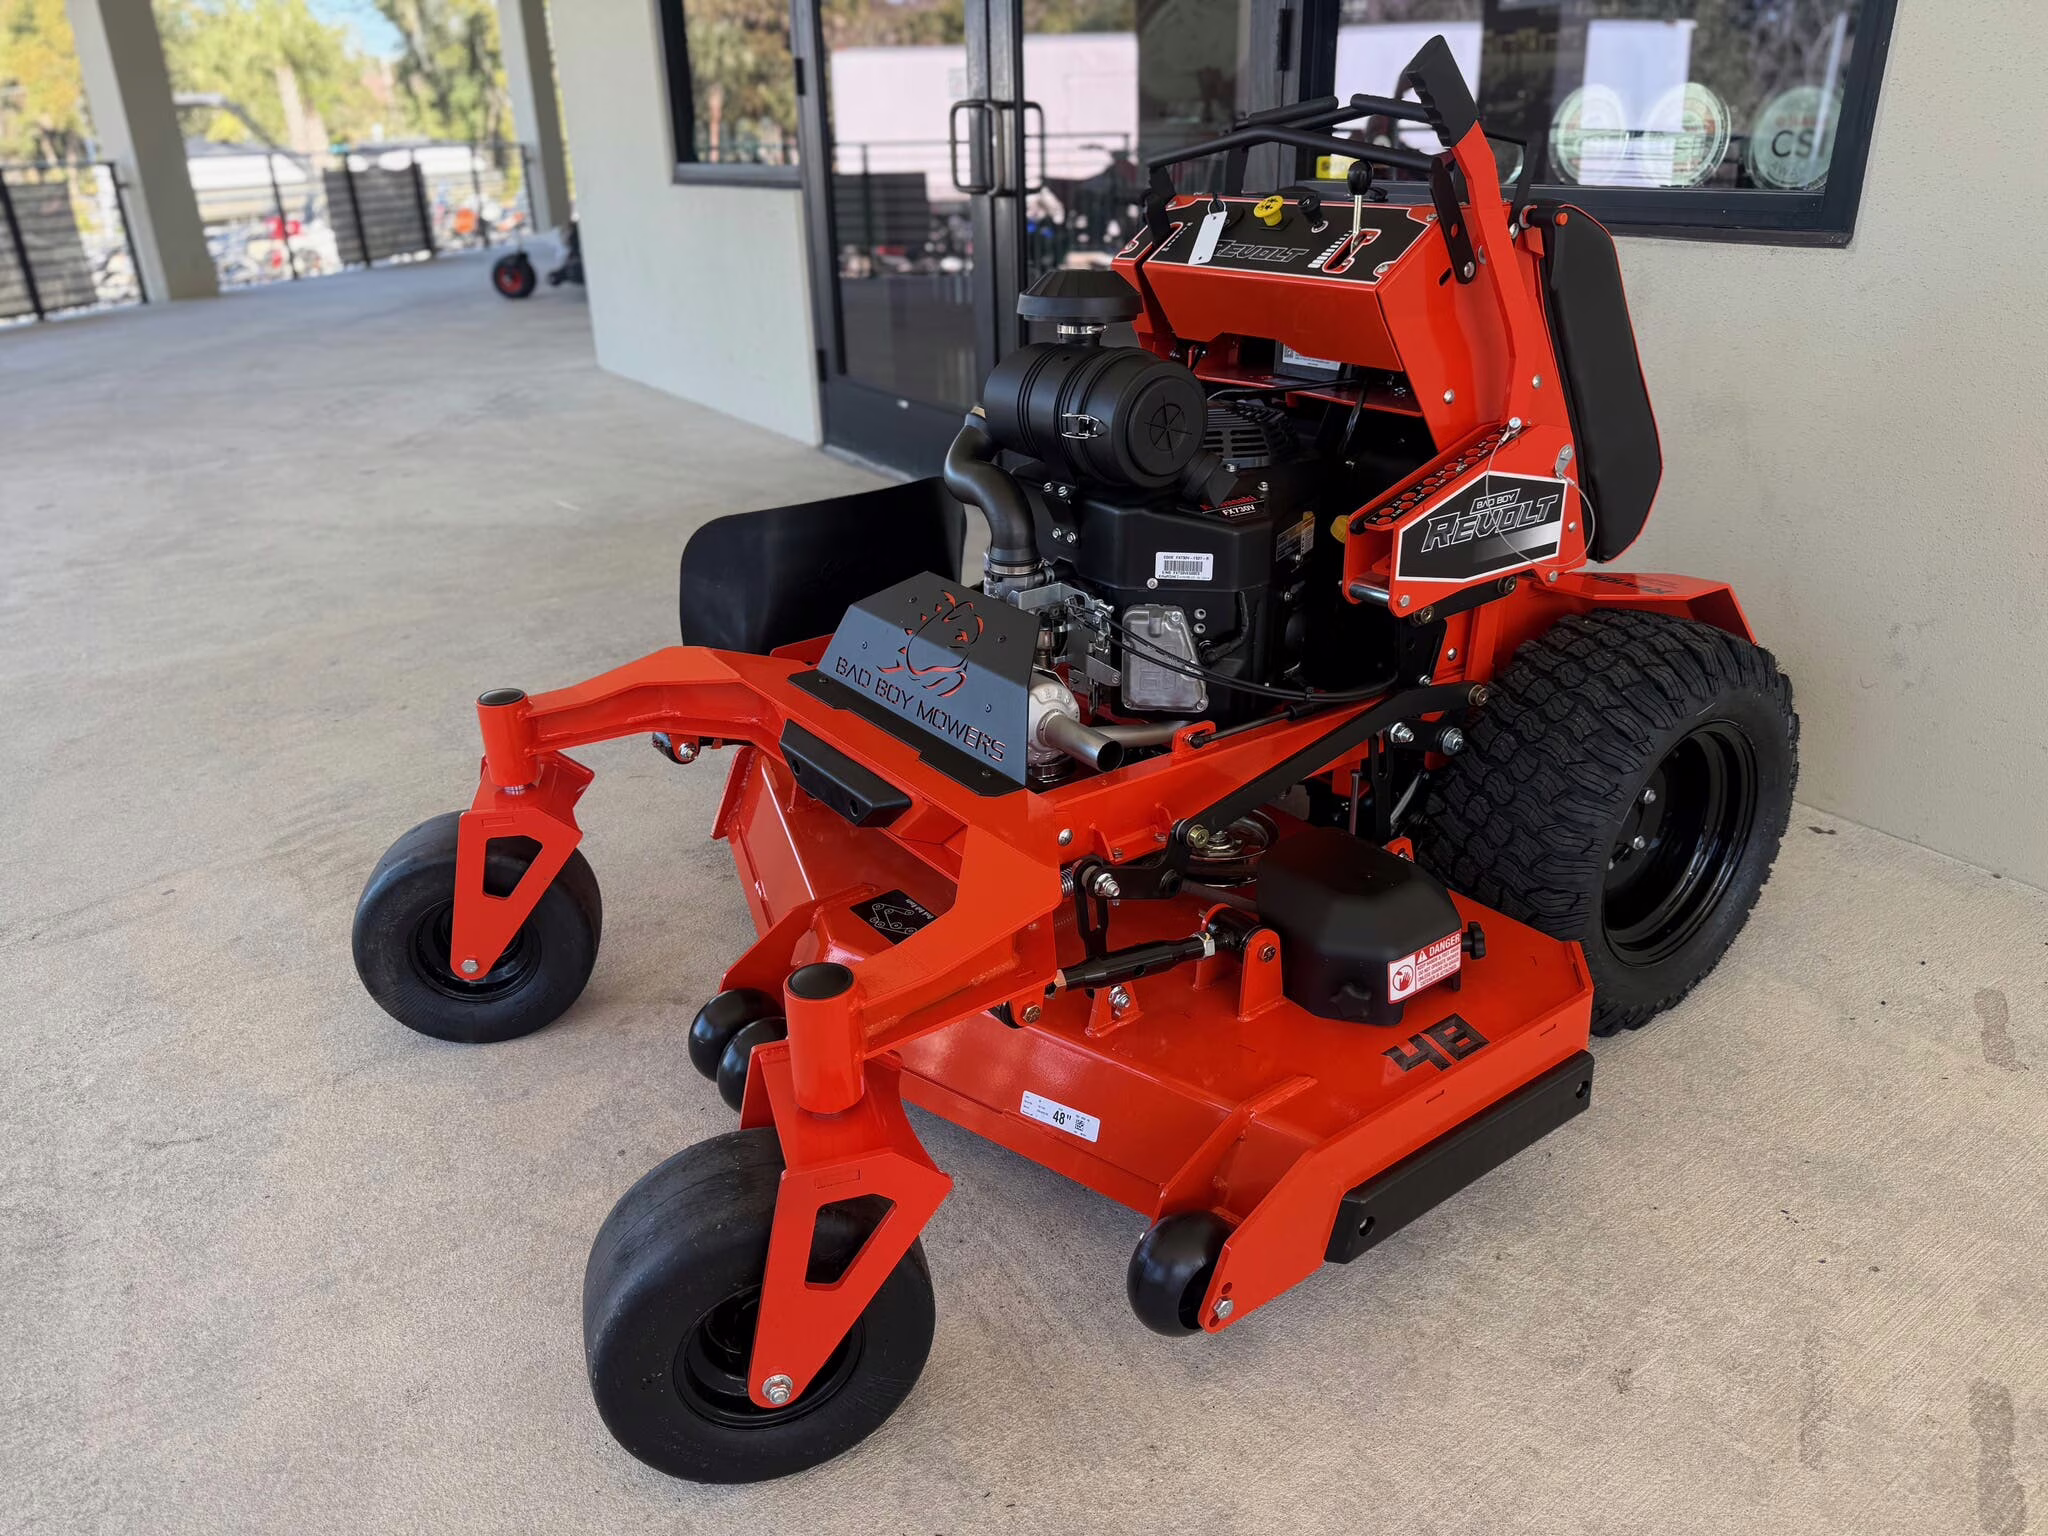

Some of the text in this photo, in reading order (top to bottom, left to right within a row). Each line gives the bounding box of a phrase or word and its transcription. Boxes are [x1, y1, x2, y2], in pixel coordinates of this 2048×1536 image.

[1222, 504, 1256, 516] FX730V
[1476, 493, 1516, 509] BAD BOY
[1421, 494, 1560, 553] REVOLT
[835, 656, 1006, 762] BAD BOY MOWERS
[1429, 933, 1460, 956] DANGER
[1381, 1013, 1490, 1072] 48
